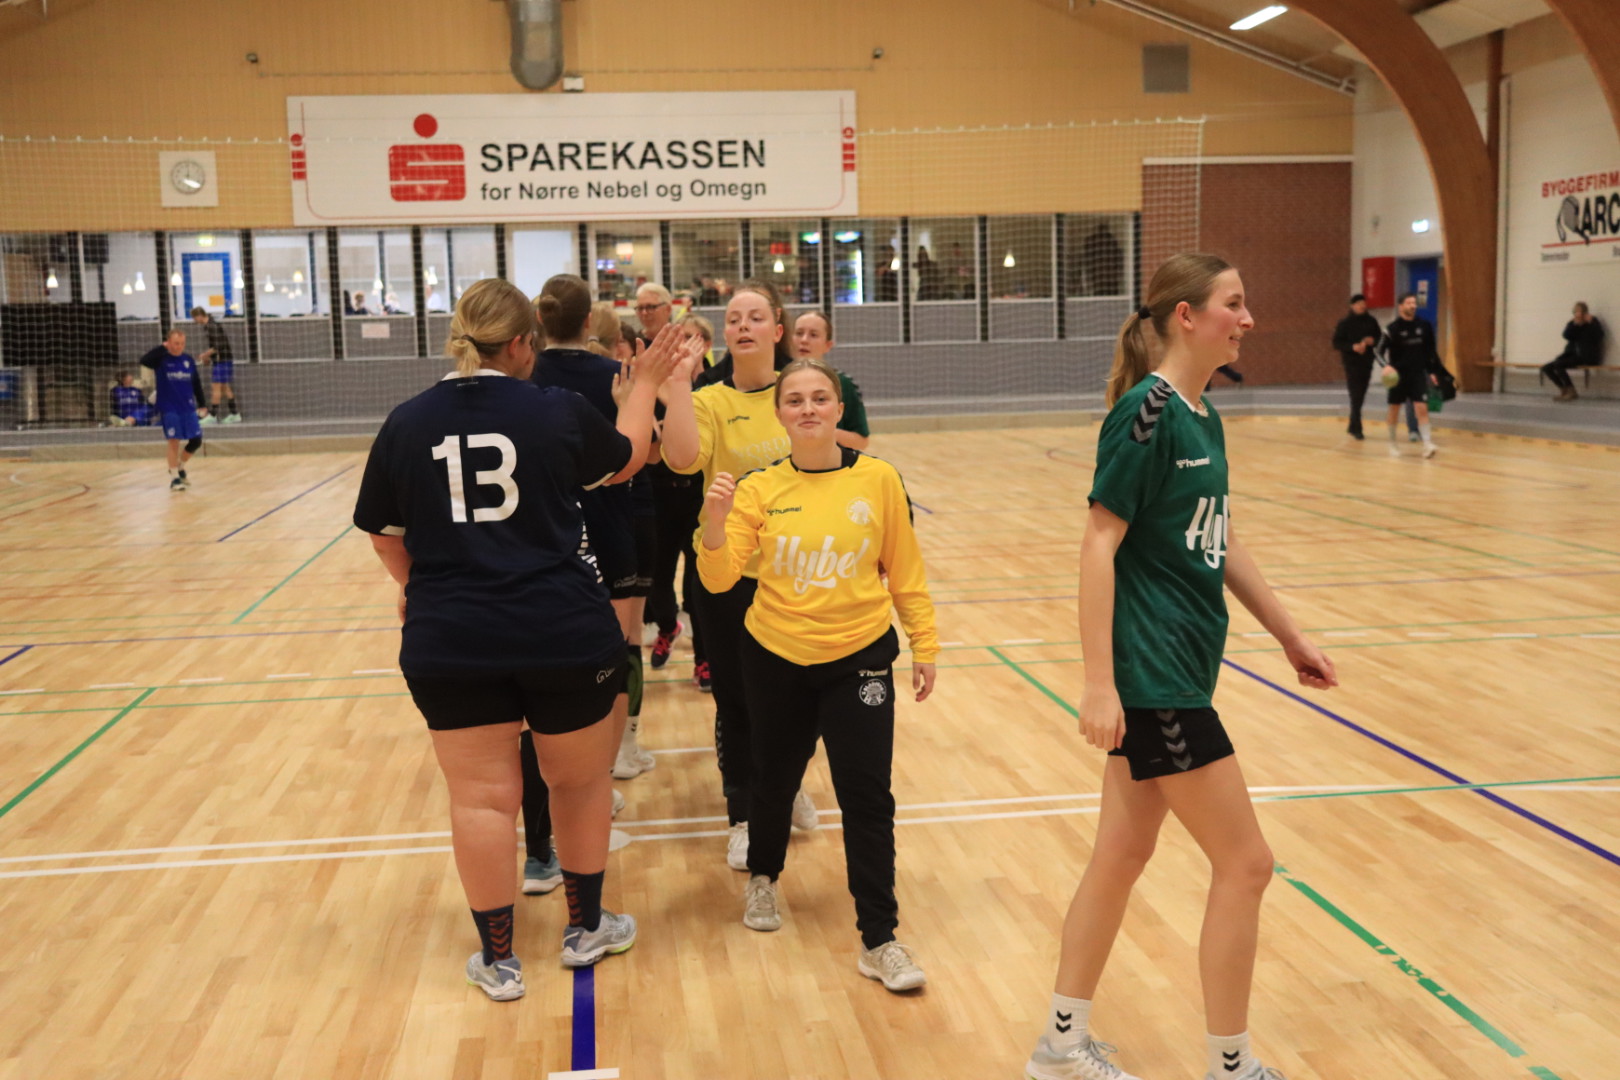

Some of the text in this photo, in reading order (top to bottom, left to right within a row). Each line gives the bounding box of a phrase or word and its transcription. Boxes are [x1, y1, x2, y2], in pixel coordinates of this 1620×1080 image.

[480, 139, 765, 172] SPAREKASSEN
[480, 179, 767, 202] for Nørre Nebel og Omegn
[431, 432, 520, 523] 13
